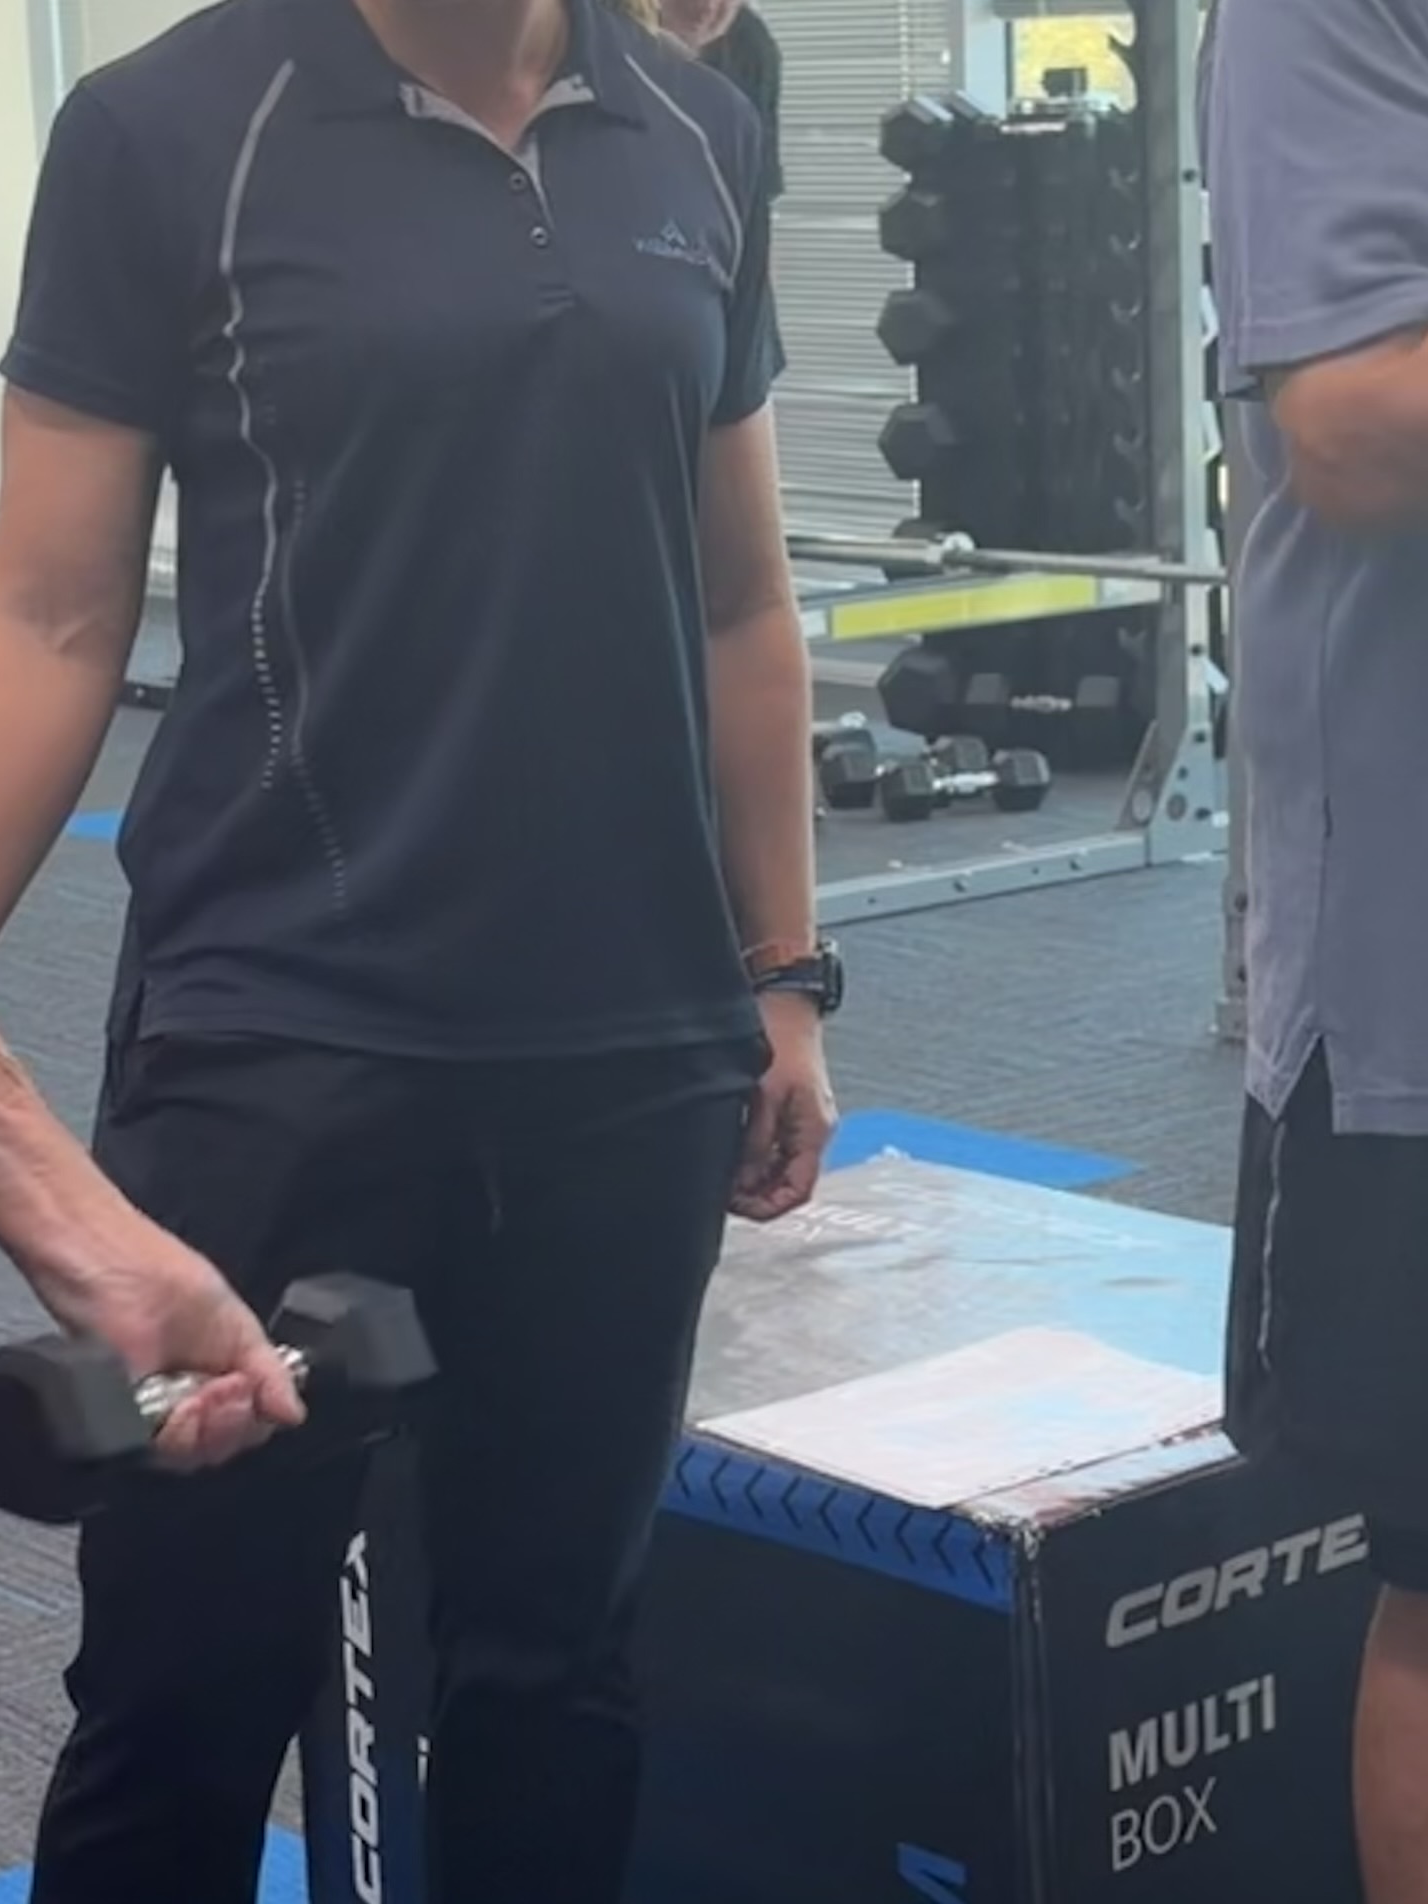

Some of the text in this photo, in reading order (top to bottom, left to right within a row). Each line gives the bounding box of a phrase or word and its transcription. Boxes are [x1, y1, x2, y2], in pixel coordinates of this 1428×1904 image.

[1106, 1513, 1370, 1649] CORTE
[1108, 1673, 1276, 1792] MULTI
[1111, 1776, 1217, 1872] BOX
